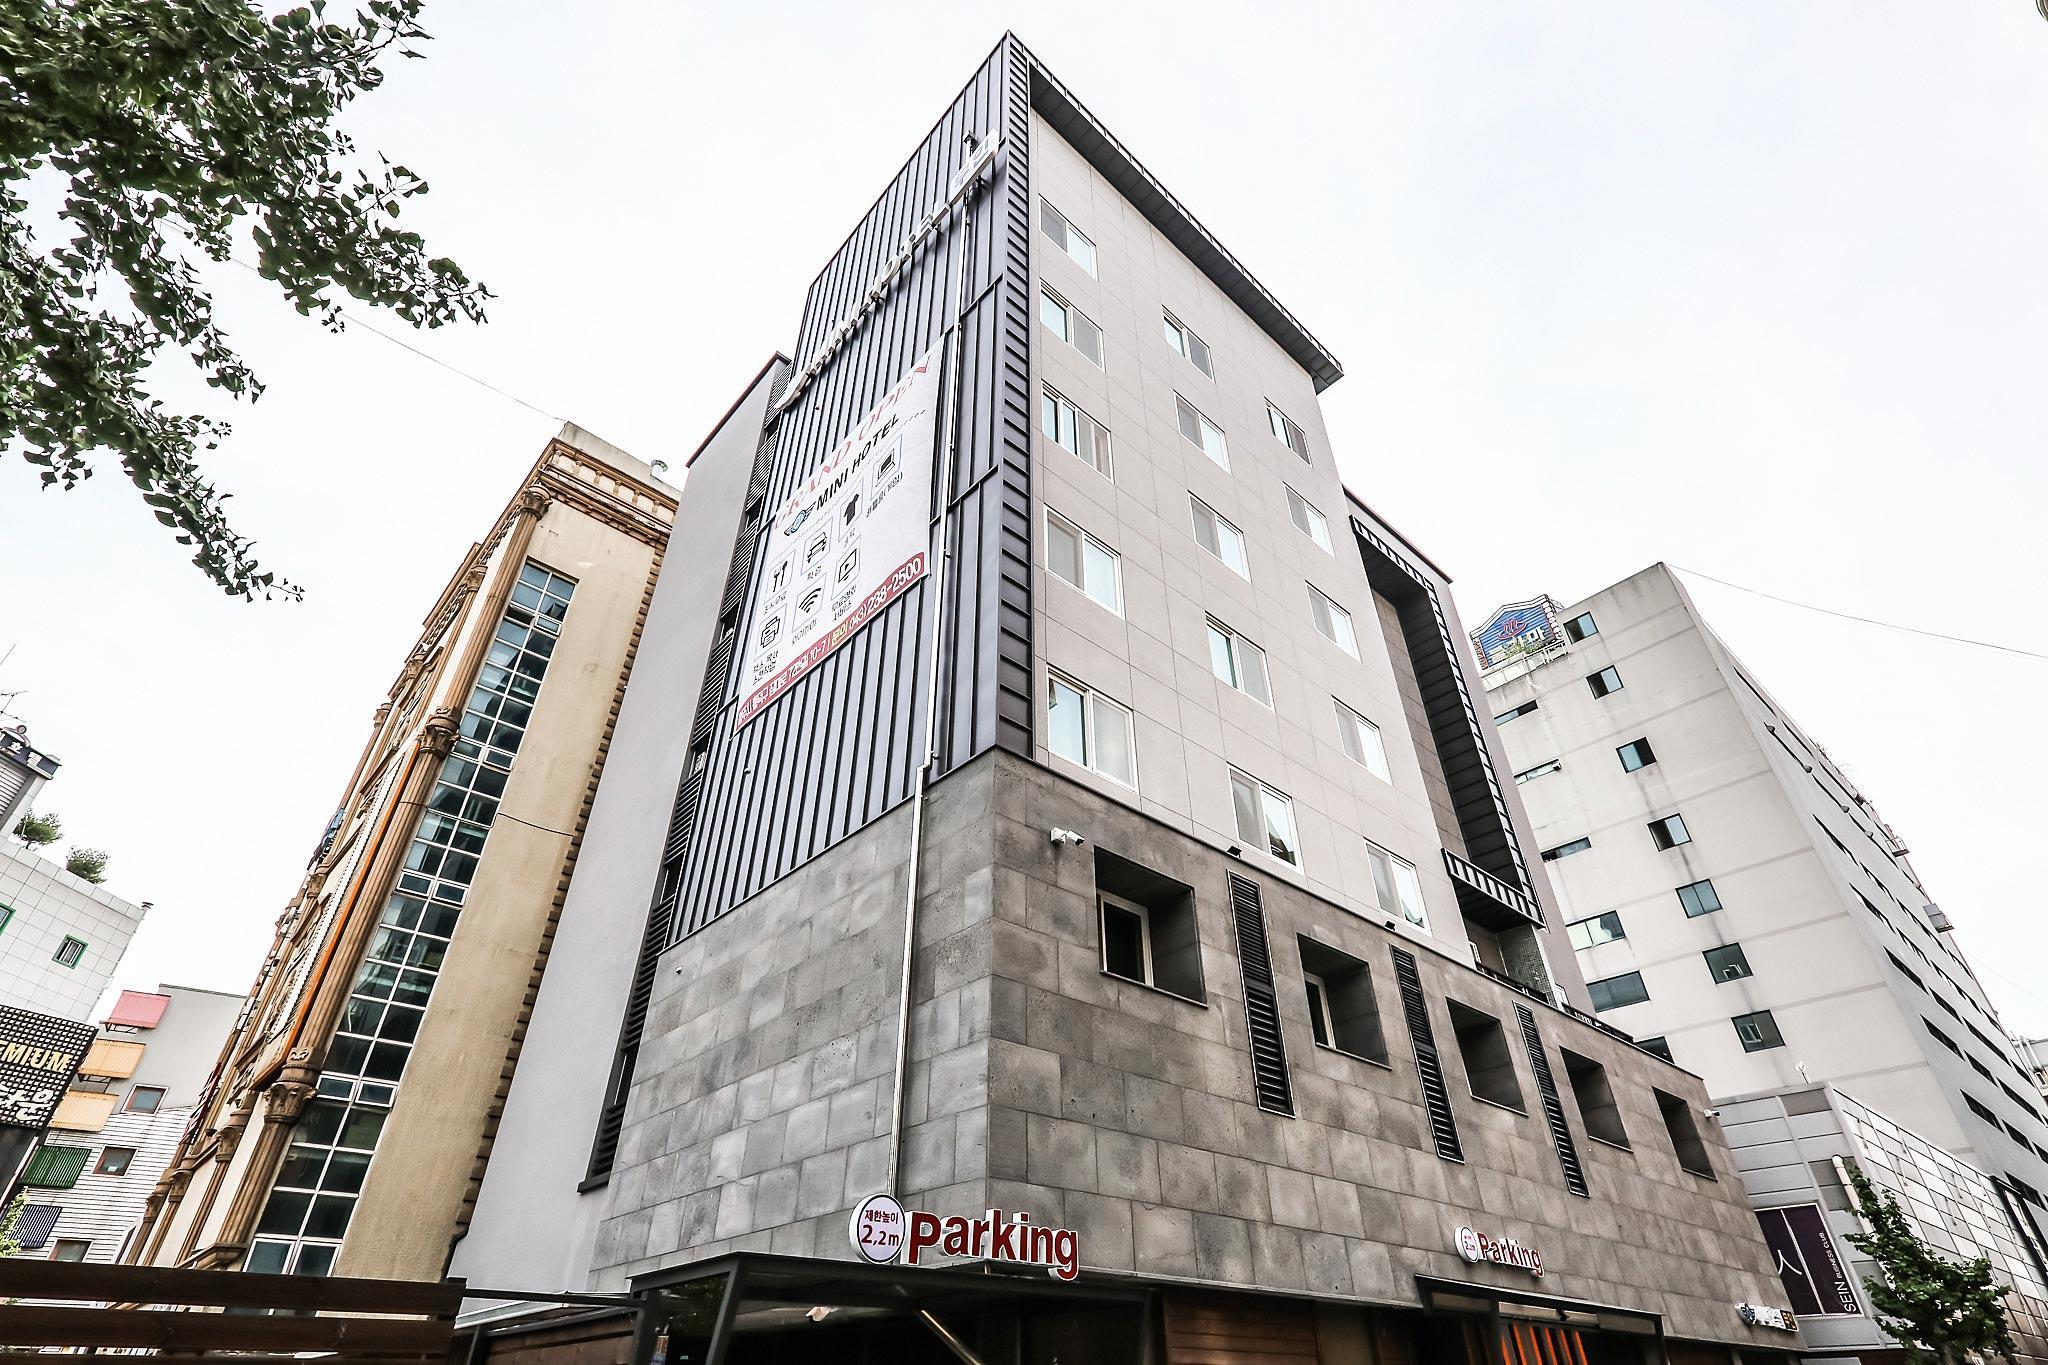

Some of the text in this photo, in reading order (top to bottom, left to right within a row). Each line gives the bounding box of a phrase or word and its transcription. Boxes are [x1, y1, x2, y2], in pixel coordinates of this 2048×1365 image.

[862, 200, 950, 312] HOTEL
[774, 440, 852, 530] GRAND
[858, 354, 932, 441] OPEN
[816, 468, 849, 511] MINI
[851, 413, 899, 474] HOTEL
[809, 638, 827, 662] 10-7
[831, 620, 849, 646] 문의
[864, 1208, 899, 1225] 제한높이
[907, 1209, 1078, 1281] Parking
[1477, 1232, 1545, 1278] Parking
[1818, 1231, 1857, 1313] SEIN BUSINESS CLUB
